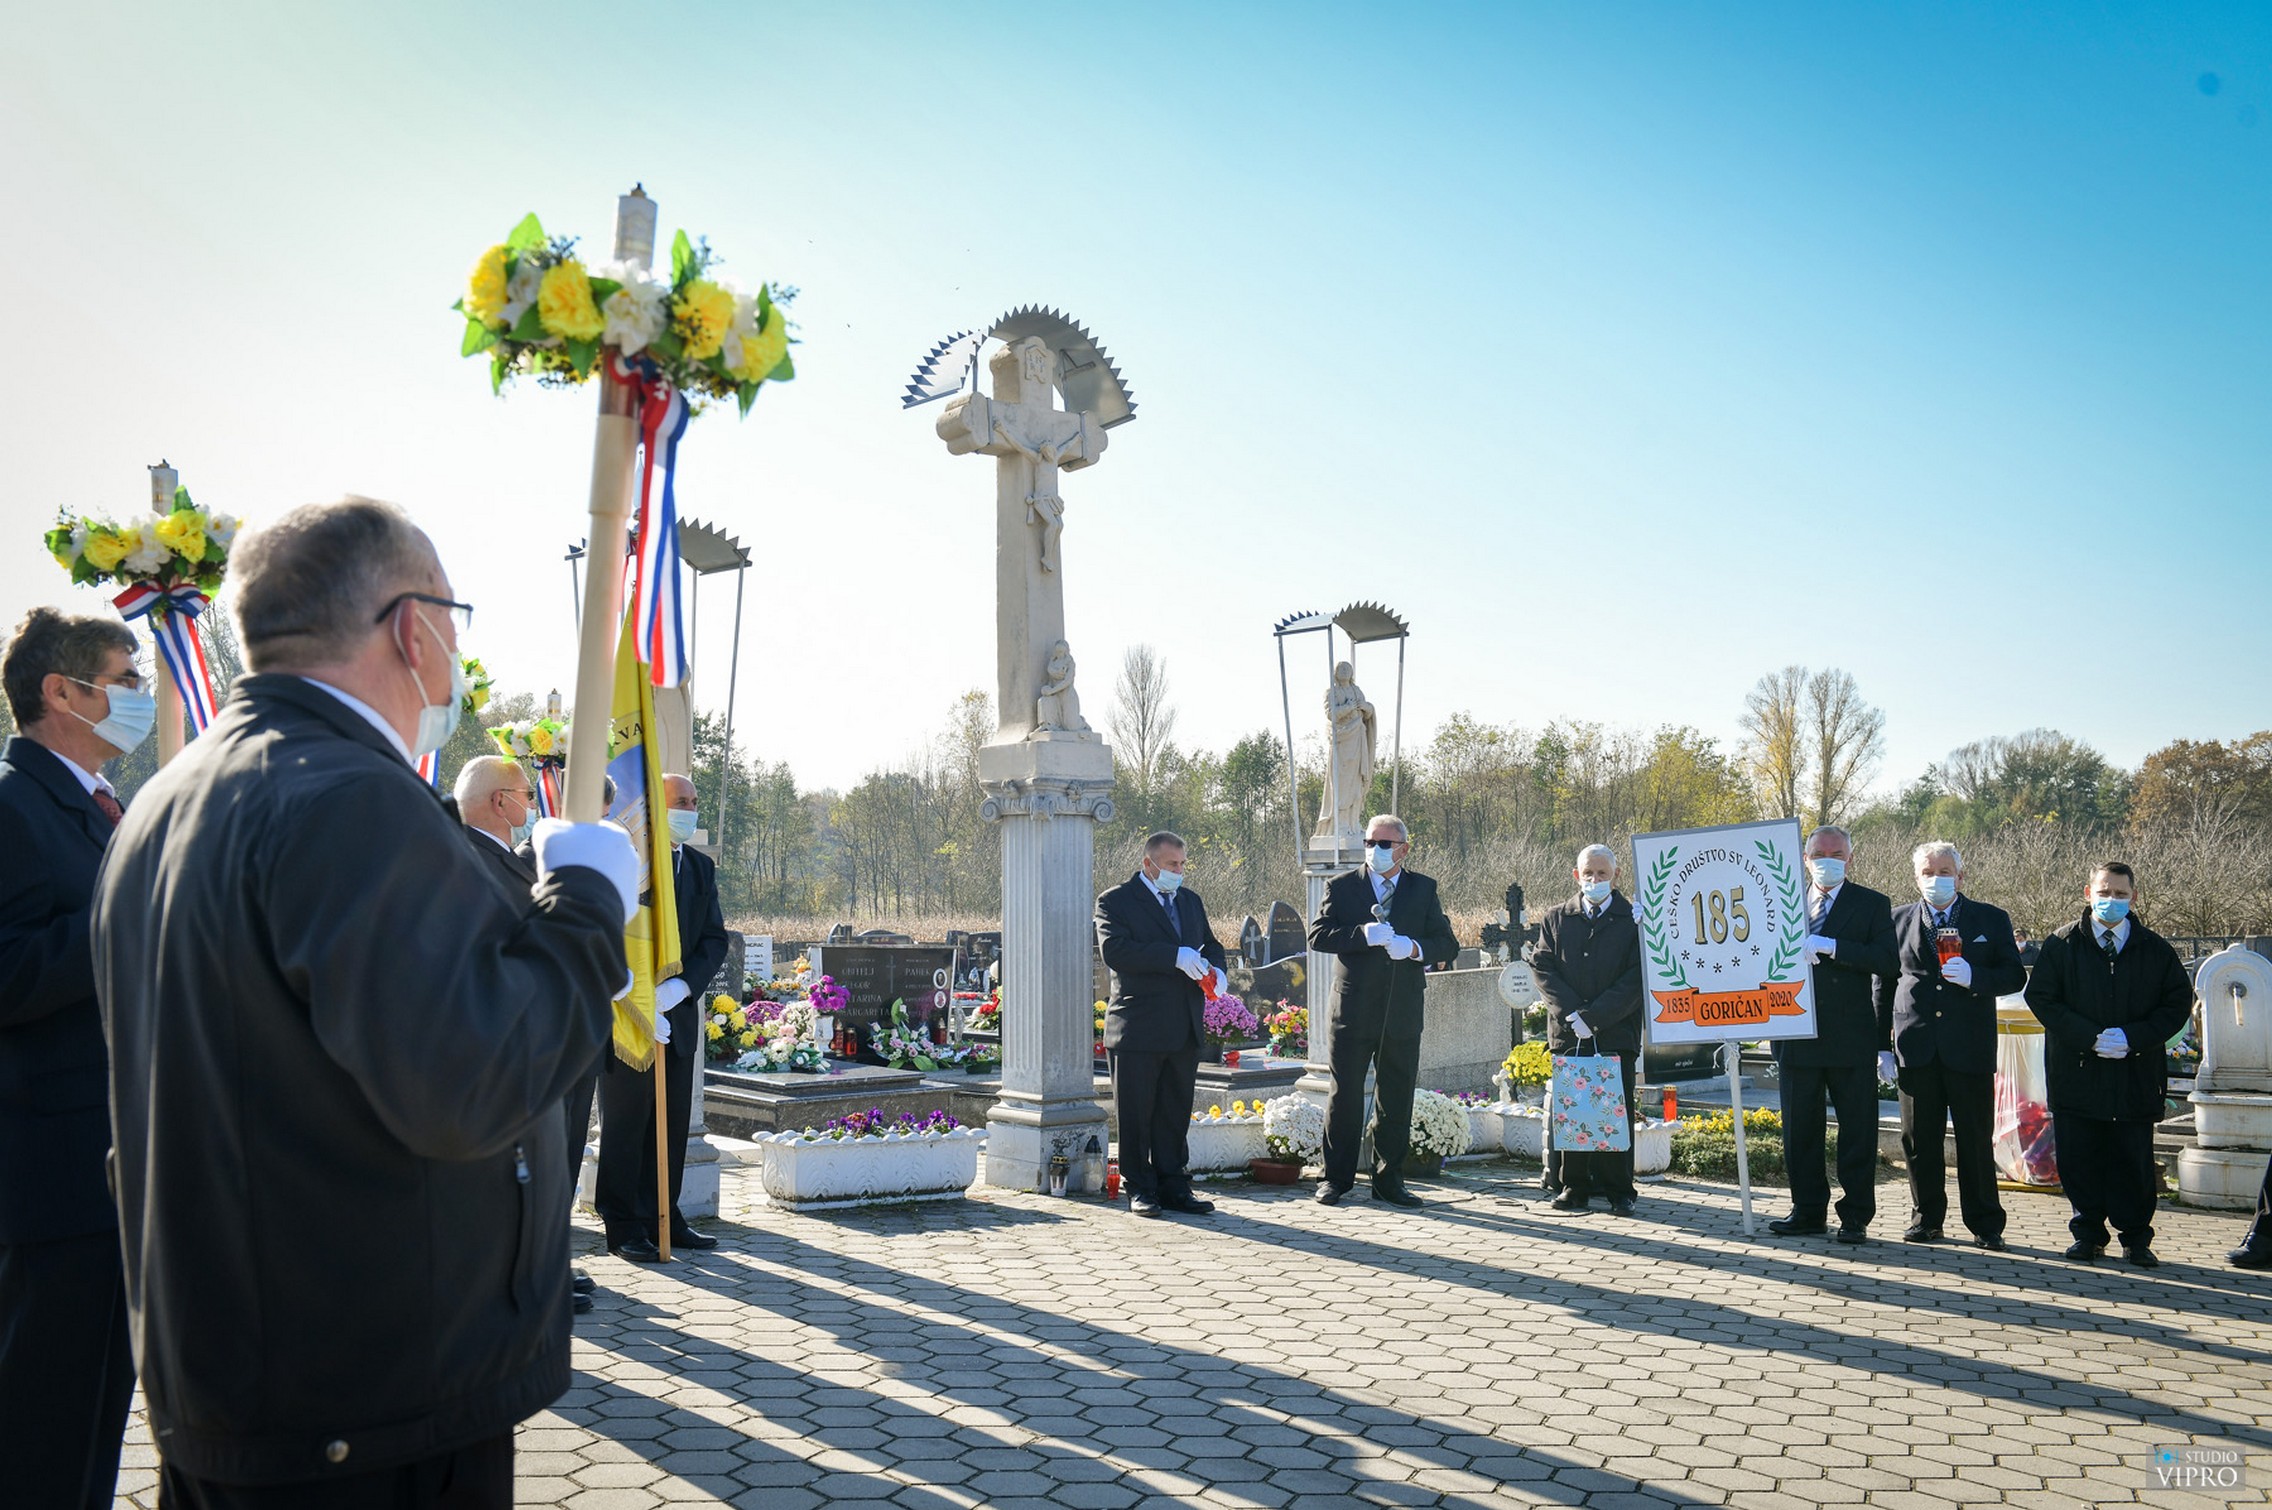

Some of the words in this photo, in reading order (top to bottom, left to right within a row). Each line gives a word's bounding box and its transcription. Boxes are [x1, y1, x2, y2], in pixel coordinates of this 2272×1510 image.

[1678, 848, 1726, 883] DRUŠTVO
[1744, 859, 1776, 933] LEONARD
[1691, 885, 1750, 945] 185
[1667, 996, 1690, 1014] 1835
[1700, 995, 1764, 1021] GORIČAN
[1770, 991, 1793, 1008] 2020
